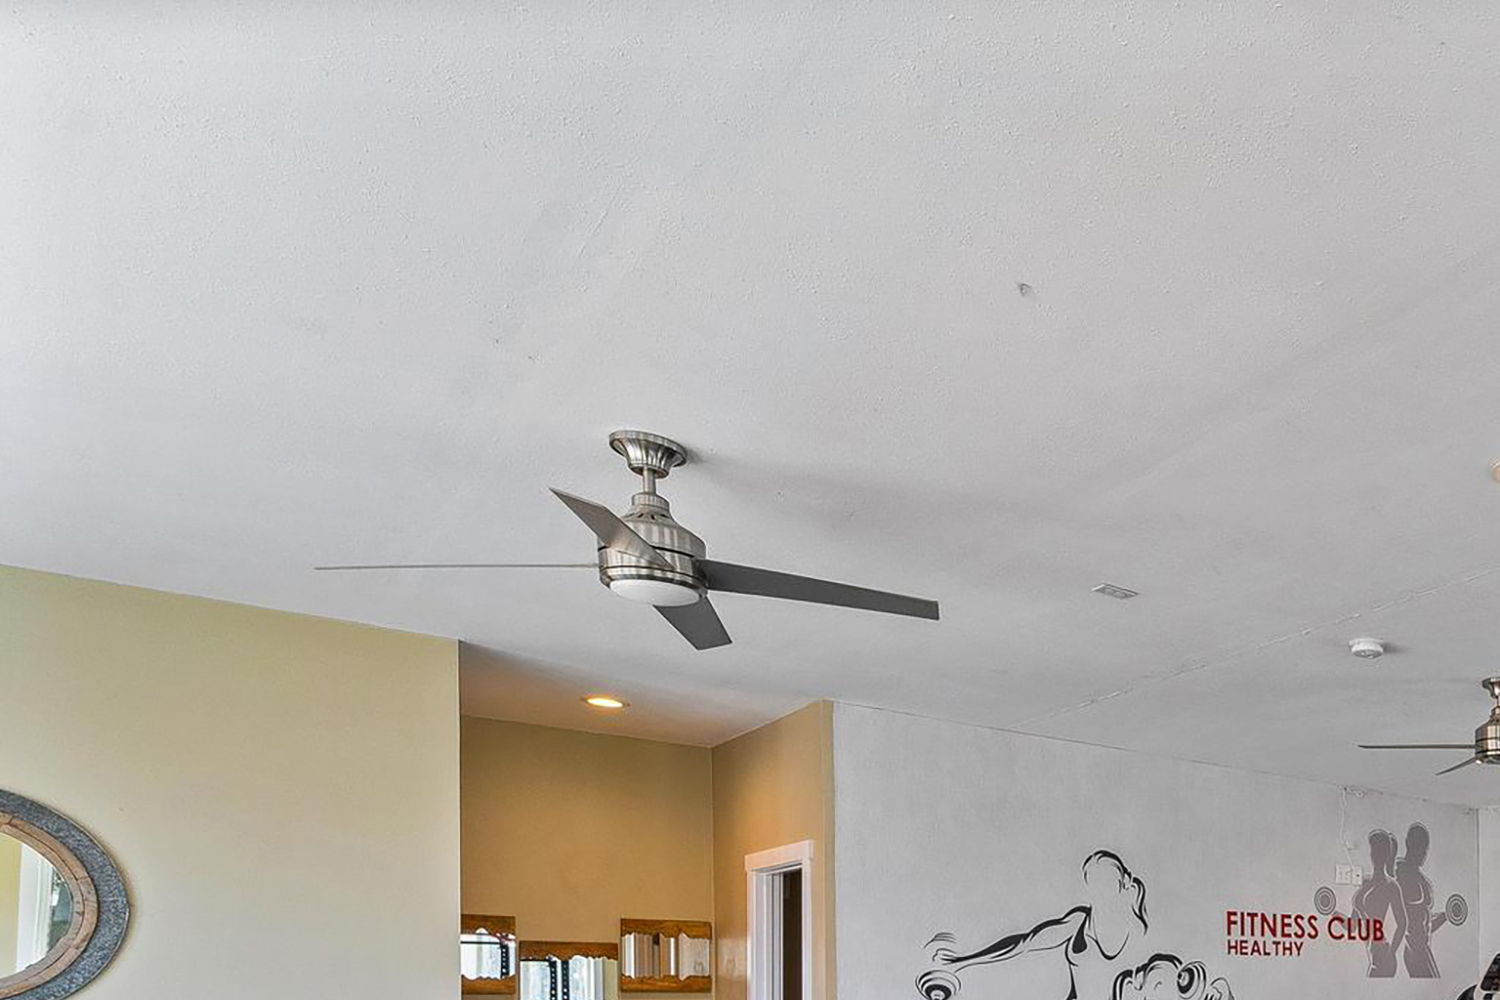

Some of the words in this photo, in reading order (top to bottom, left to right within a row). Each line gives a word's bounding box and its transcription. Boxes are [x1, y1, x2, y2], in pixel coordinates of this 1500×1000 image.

[1226, 911, 1319, 939] FITNESS
[1327, 916, 1384, 941] CLUB
[1227, 940, 1304, 956] HEALTHY
